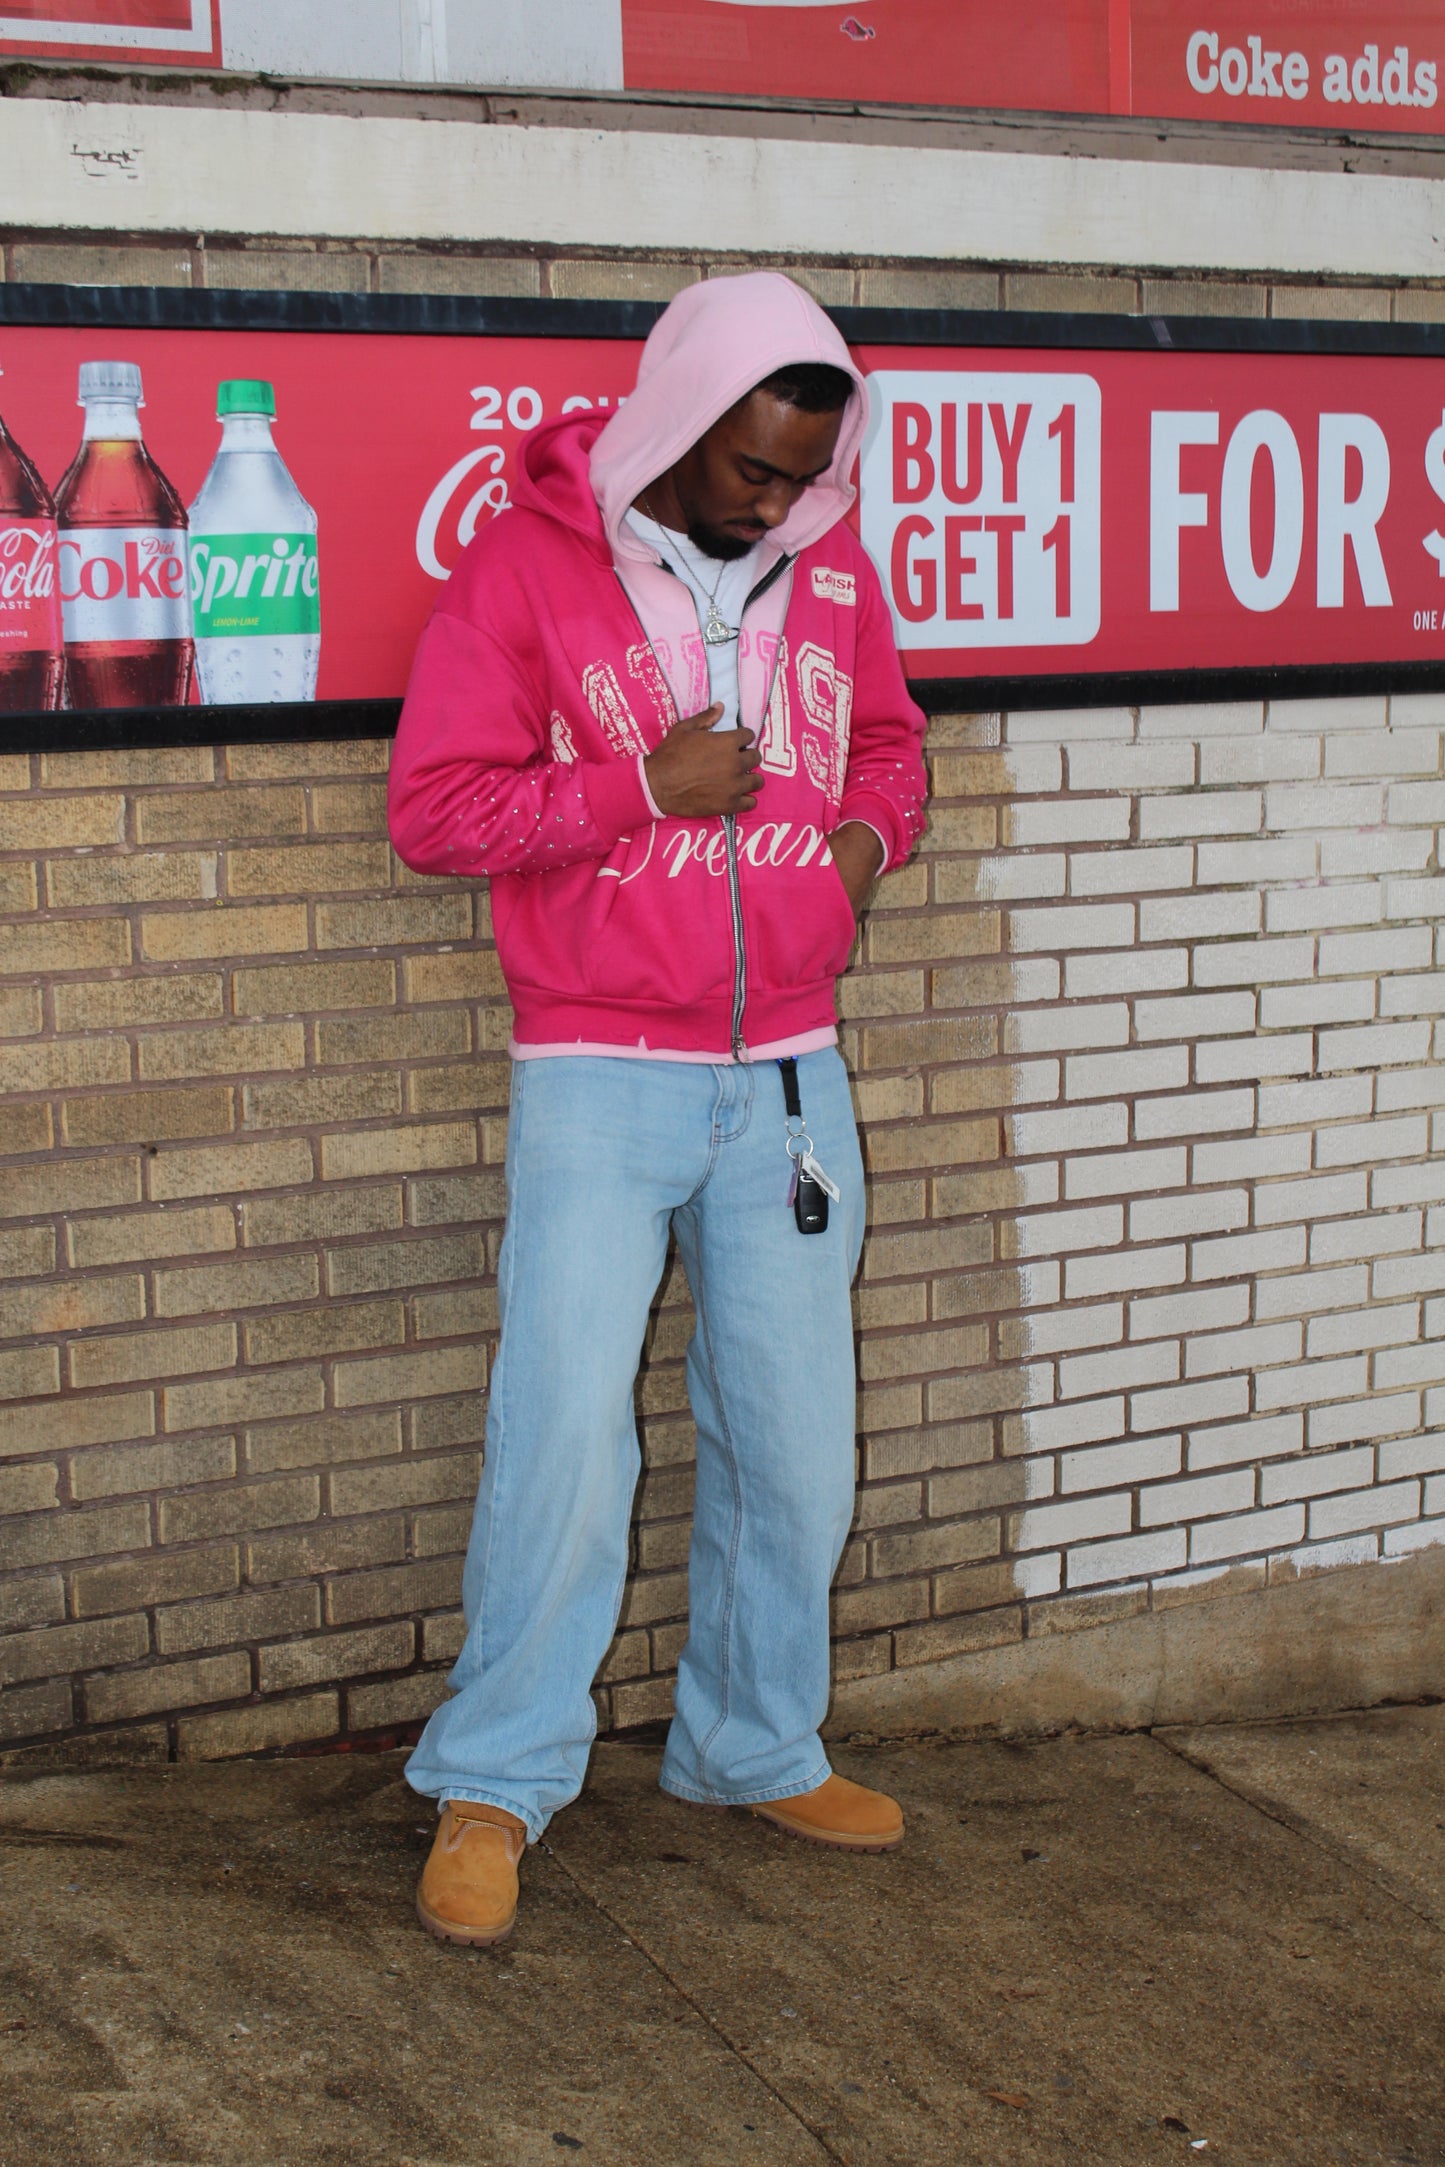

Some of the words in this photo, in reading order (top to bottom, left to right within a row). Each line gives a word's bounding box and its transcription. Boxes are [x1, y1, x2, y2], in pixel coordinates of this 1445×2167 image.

[1185, 29, 1310, 101] Coke
[1322, 43, 1439, 109] adds
[469, 386, 544, 431] 20
[892, 401, 1032, 505] BUY
[1048, 403, 1077, 503] 1
[1150, 408, 1394, 613] FOR
[57, 541, 185, 602] Coke
[142, 536, 175, 556] Diet
[190, 538, 318, 613] Sprite
[890, 513, 1026, 623] GET
[1042, 514, 1071, 618] 1
[212, 616, 260, 628] LEMON-LIME
[1413, 610, 1438, 632] ONE
